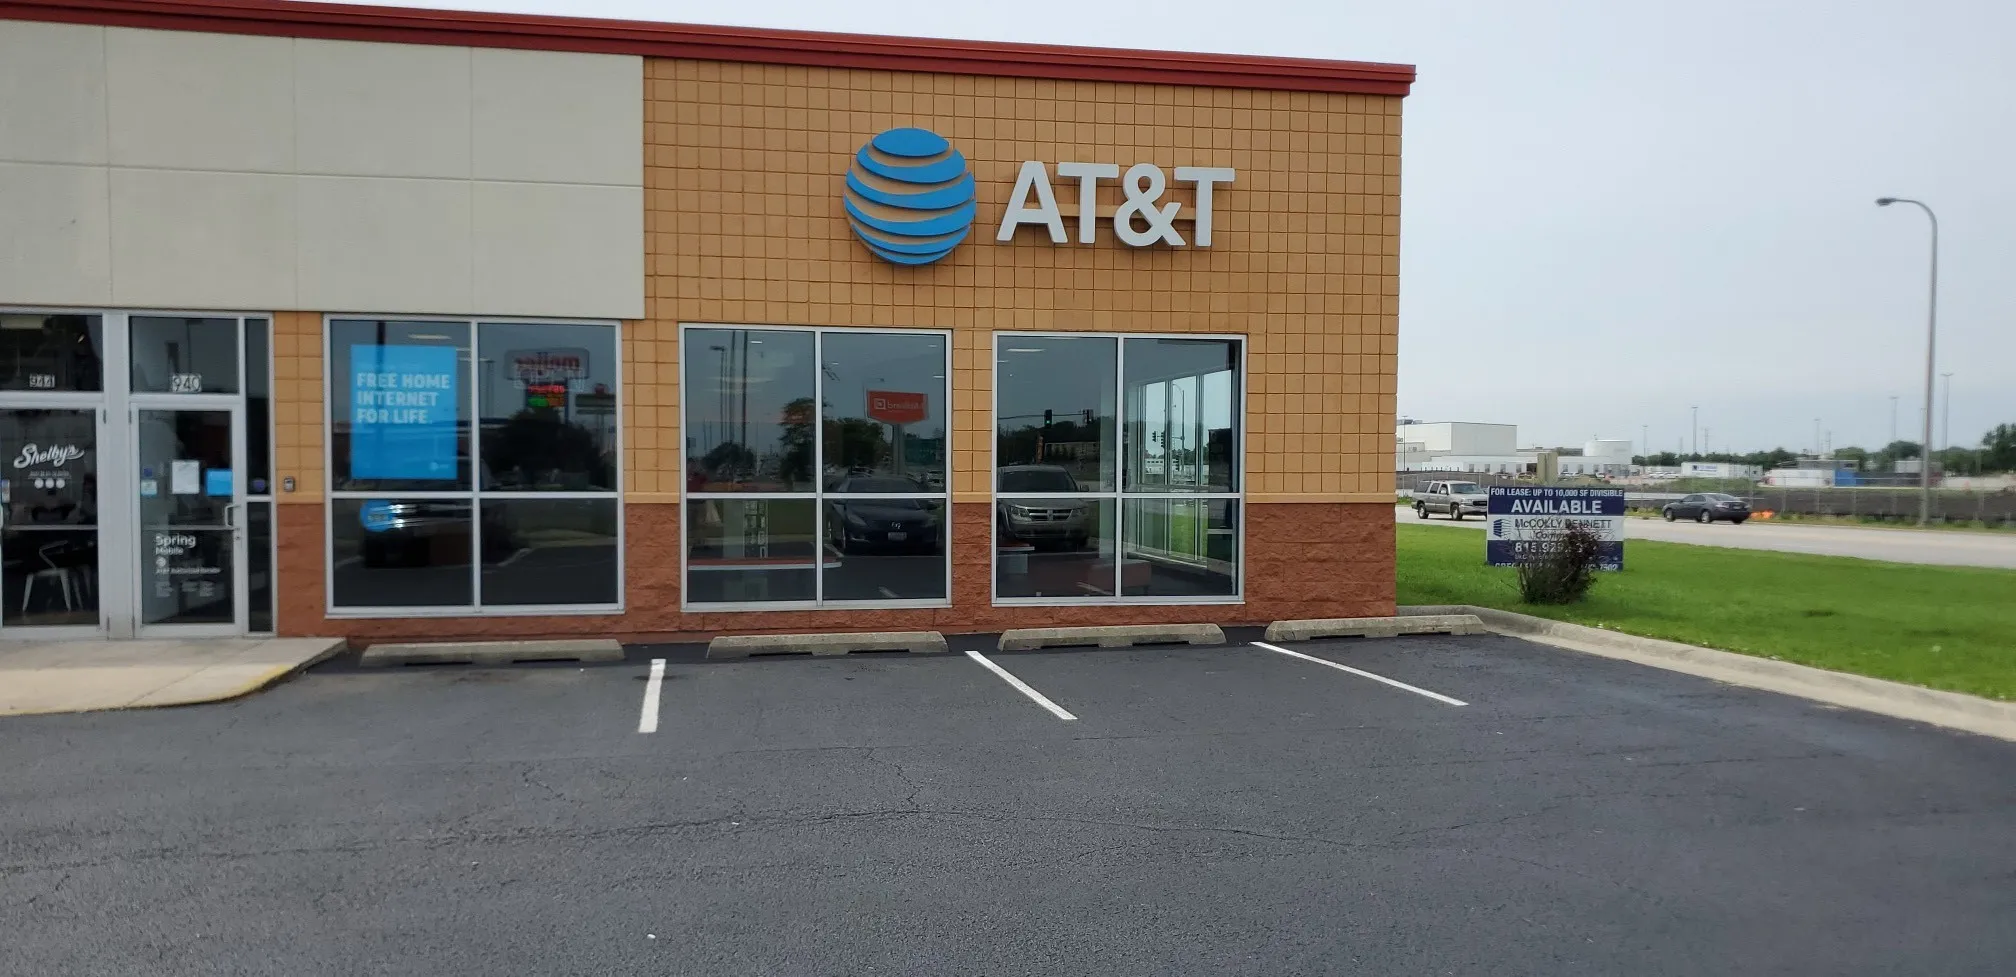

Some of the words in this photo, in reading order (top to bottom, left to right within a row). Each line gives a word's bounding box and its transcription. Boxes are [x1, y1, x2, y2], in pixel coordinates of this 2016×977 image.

[995, 160, 1236, 248] AT&T
[173, 374, 201, 392] 940
[357, 373, 398, 388] FREE
[402, 374, 451, 389] HOME
[357, 391, 439, 406] INTERNET
[357, 408, 390, 424] FOR
[393, 409, 433, 425] LIFE.
[13, 443, 85, 469] Shelby's
[1490, 488, 1505, 496] FOR
[1506, 488, 1532, 497] LEASE:
[1533, 489, 1543, 497] UP
[1544, 489, 1554, 497] TO
[1555, 489, 1579, 498] 10,000
[1511, 499, 1603, 514] AVAILABLE
[156, 533, 196, 548] Spring
